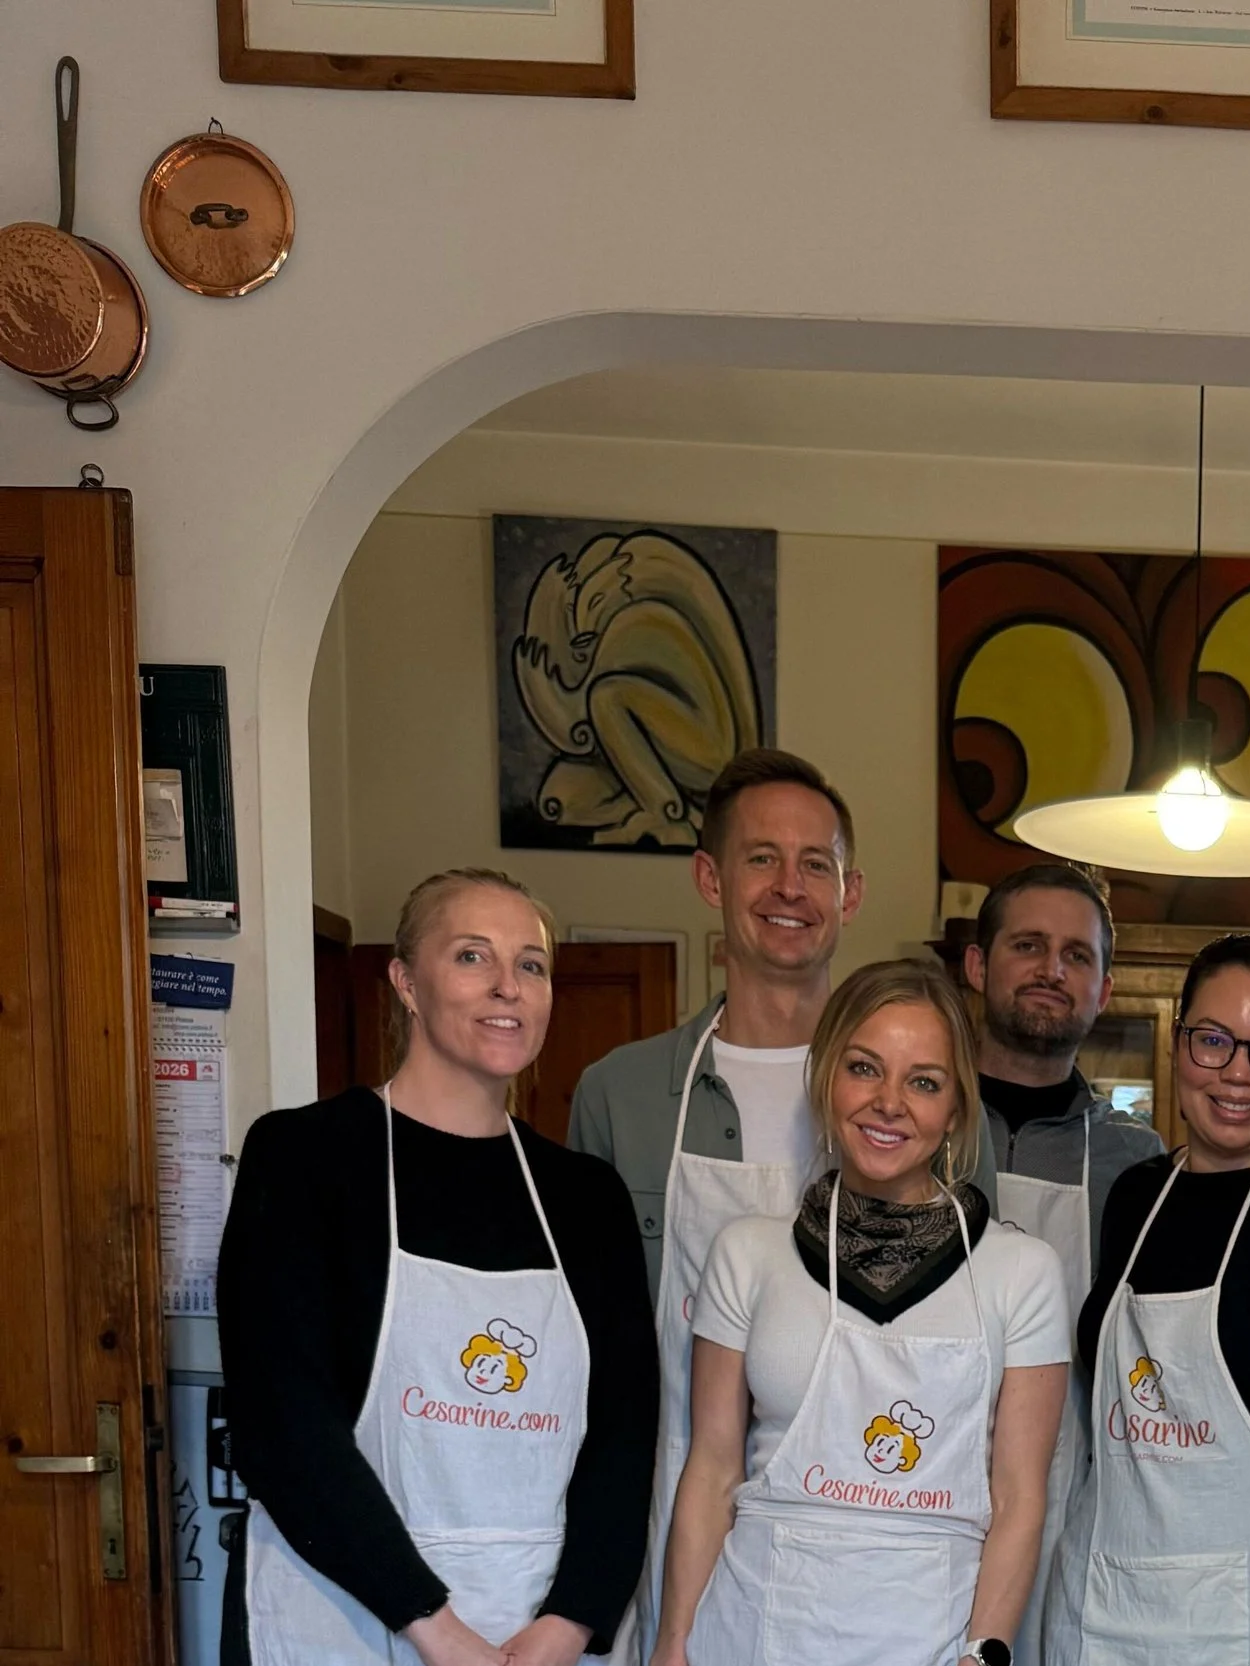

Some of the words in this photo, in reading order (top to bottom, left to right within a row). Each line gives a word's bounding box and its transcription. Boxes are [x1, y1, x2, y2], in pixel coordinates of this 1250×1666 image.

[196, 974, 220, 984] come
[181, 982, 195, 993] nel
[155, 1062, 189, 1077] 2026
[402, 1386, 562, 1434] Cesarine.com
[804, 1464, 955, 1510] Cesarine.com
